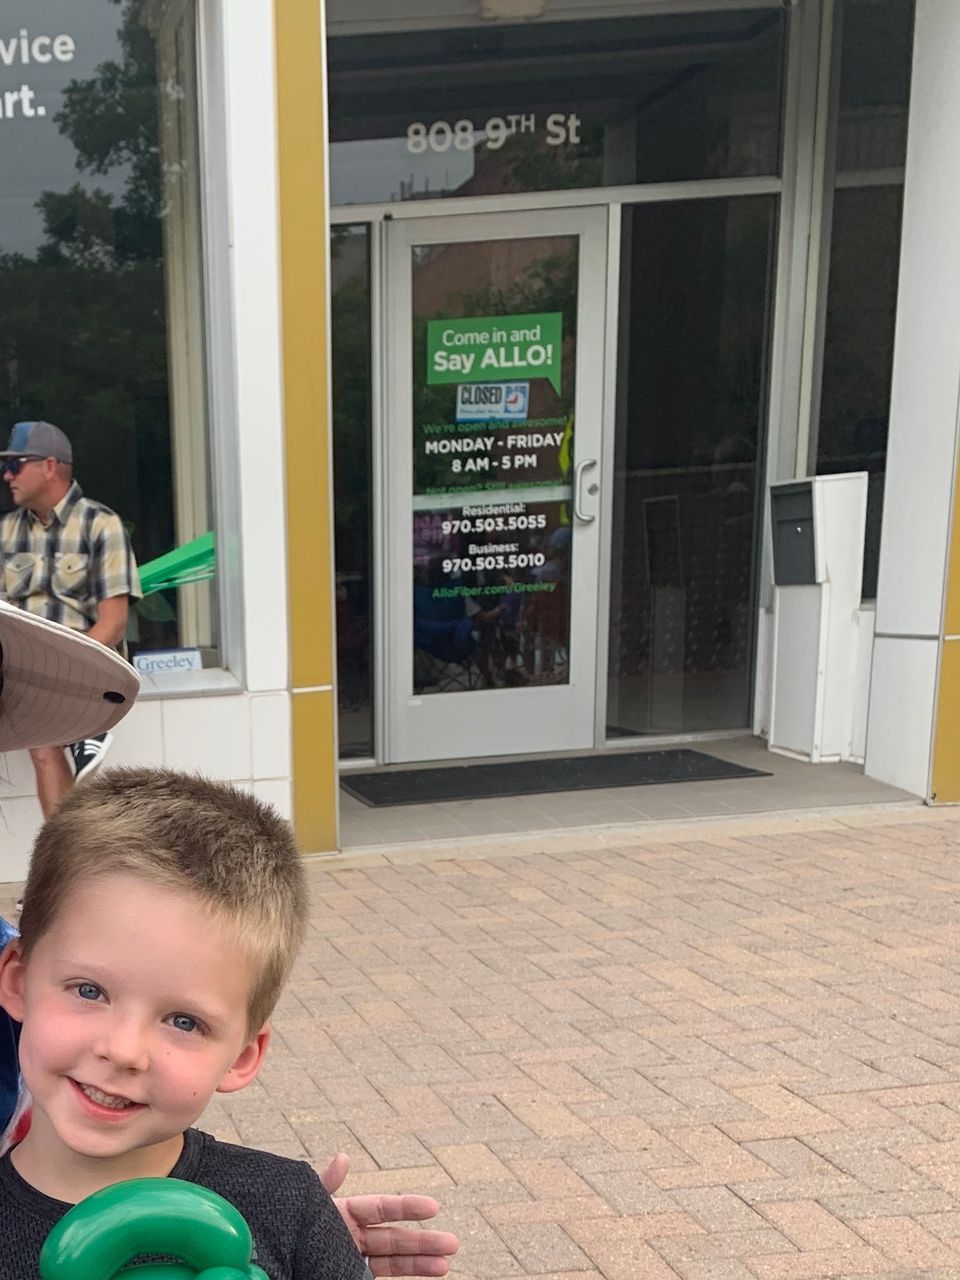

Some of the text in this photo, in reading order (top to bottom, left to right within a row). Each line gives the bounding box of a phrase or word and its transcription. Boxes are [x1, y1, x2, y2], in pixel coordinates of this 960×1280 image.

[407, 113, 581, 153] 808 9TH St
[442, 325, 540, 347] Come in and
[434, 344, 553, 374] Say ALLO!
[461, 386, 502, 405] CLOSED
[457, 421, 487, 433] open
[425, 437, 494, 454] MONDAY
[507, 432, 564, 448] FRIDAY
[451, 459, 461, 472] 8
[464, 457, 489, 471] AM
[501, 456, 511, 469] 5
[514, 454, 537, 468] PM
[462, 503, 526, 517] Residential:
[441, 515, 546, 535] 970.503.5055
[468, 543, 519, 555] Business:
[442, 553, 545, 573] 970.503.5010
[432, 581, 556, 599] AlloFiber.com/Greeley
[137, 655, 194, 671] Greeley
